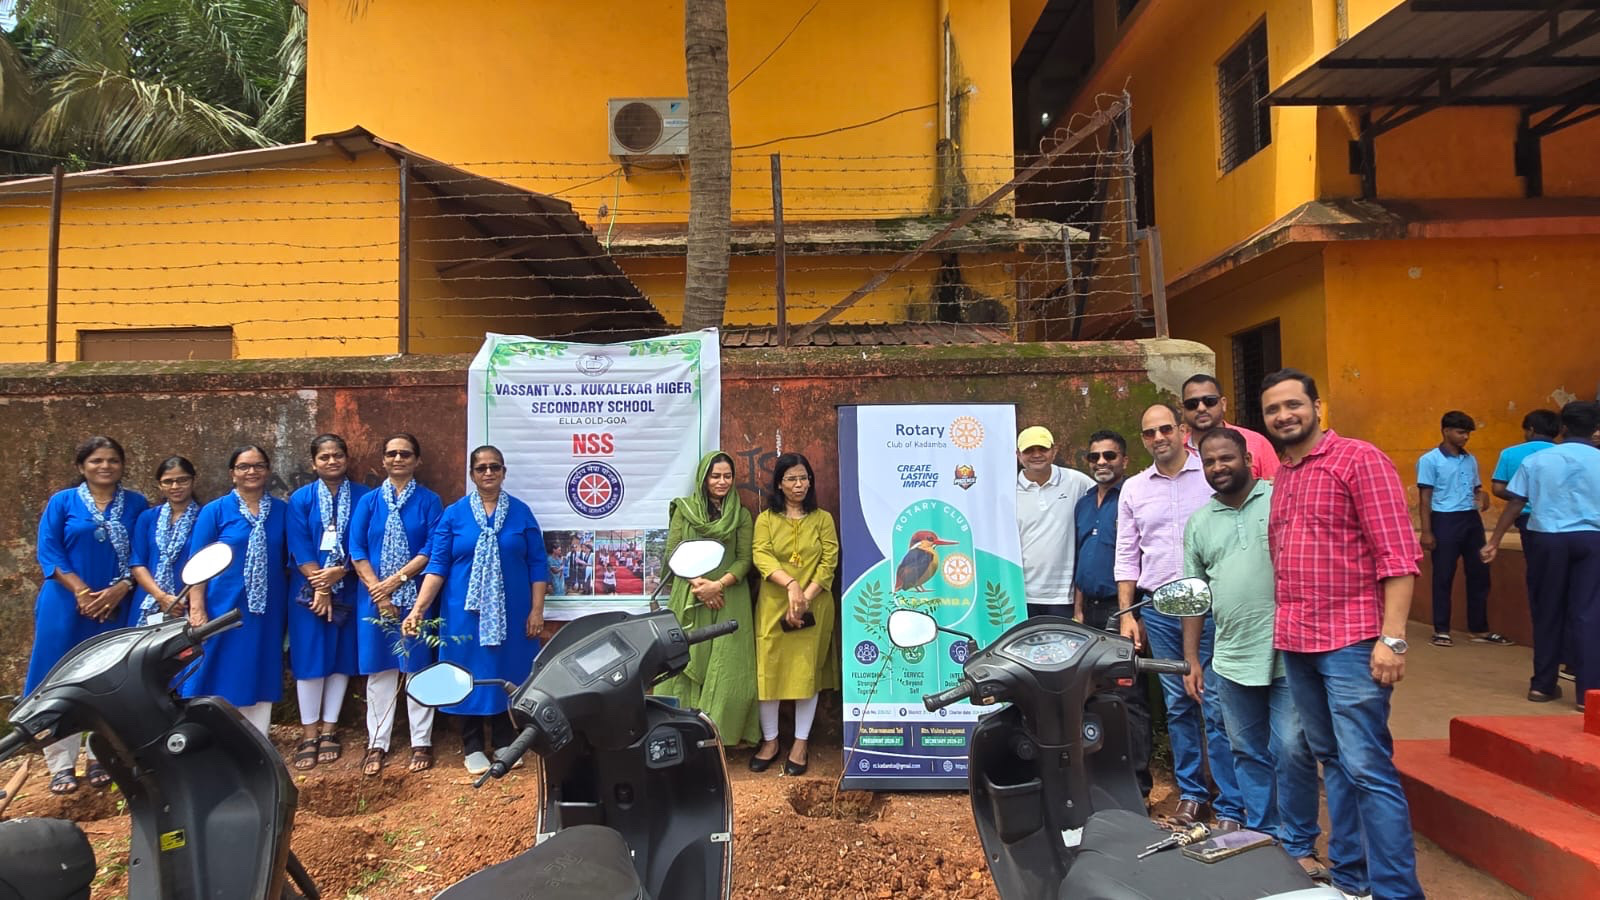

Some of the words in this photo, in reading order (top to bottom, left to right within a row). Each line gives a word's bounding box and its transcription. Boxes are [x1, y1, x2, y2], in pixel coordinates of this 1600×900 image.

[495, 383, 550, 396] VASSANT
[553, 384, 577, 396] V.S.
[581, 383, 652, 395] KUKALEKAR
[656, 382, 692, 394] HIGER
[531, 401, 604, 414] SECONDARY
[608, 400, 655, 413] SCHOOL
[559, 417, 582, 425] ELLA
[584, 416, 627, 425] OLD-GOA
[895, 423, 945, 439] Rotary
[572, 432, 614, 454] NSS
[886, 440, 903, 448] Club
[905, 440, 913, 448] of
[914, 440, 947, 448] Kadamba
[897, 464, 932, 472] CREATE
[900, 472, 939, 481] LASTING
[902, 480, 938, 488] IMPACT
[895, 502, 937, 532] ROTARY
[943, 506, 969, 532] CLUB
